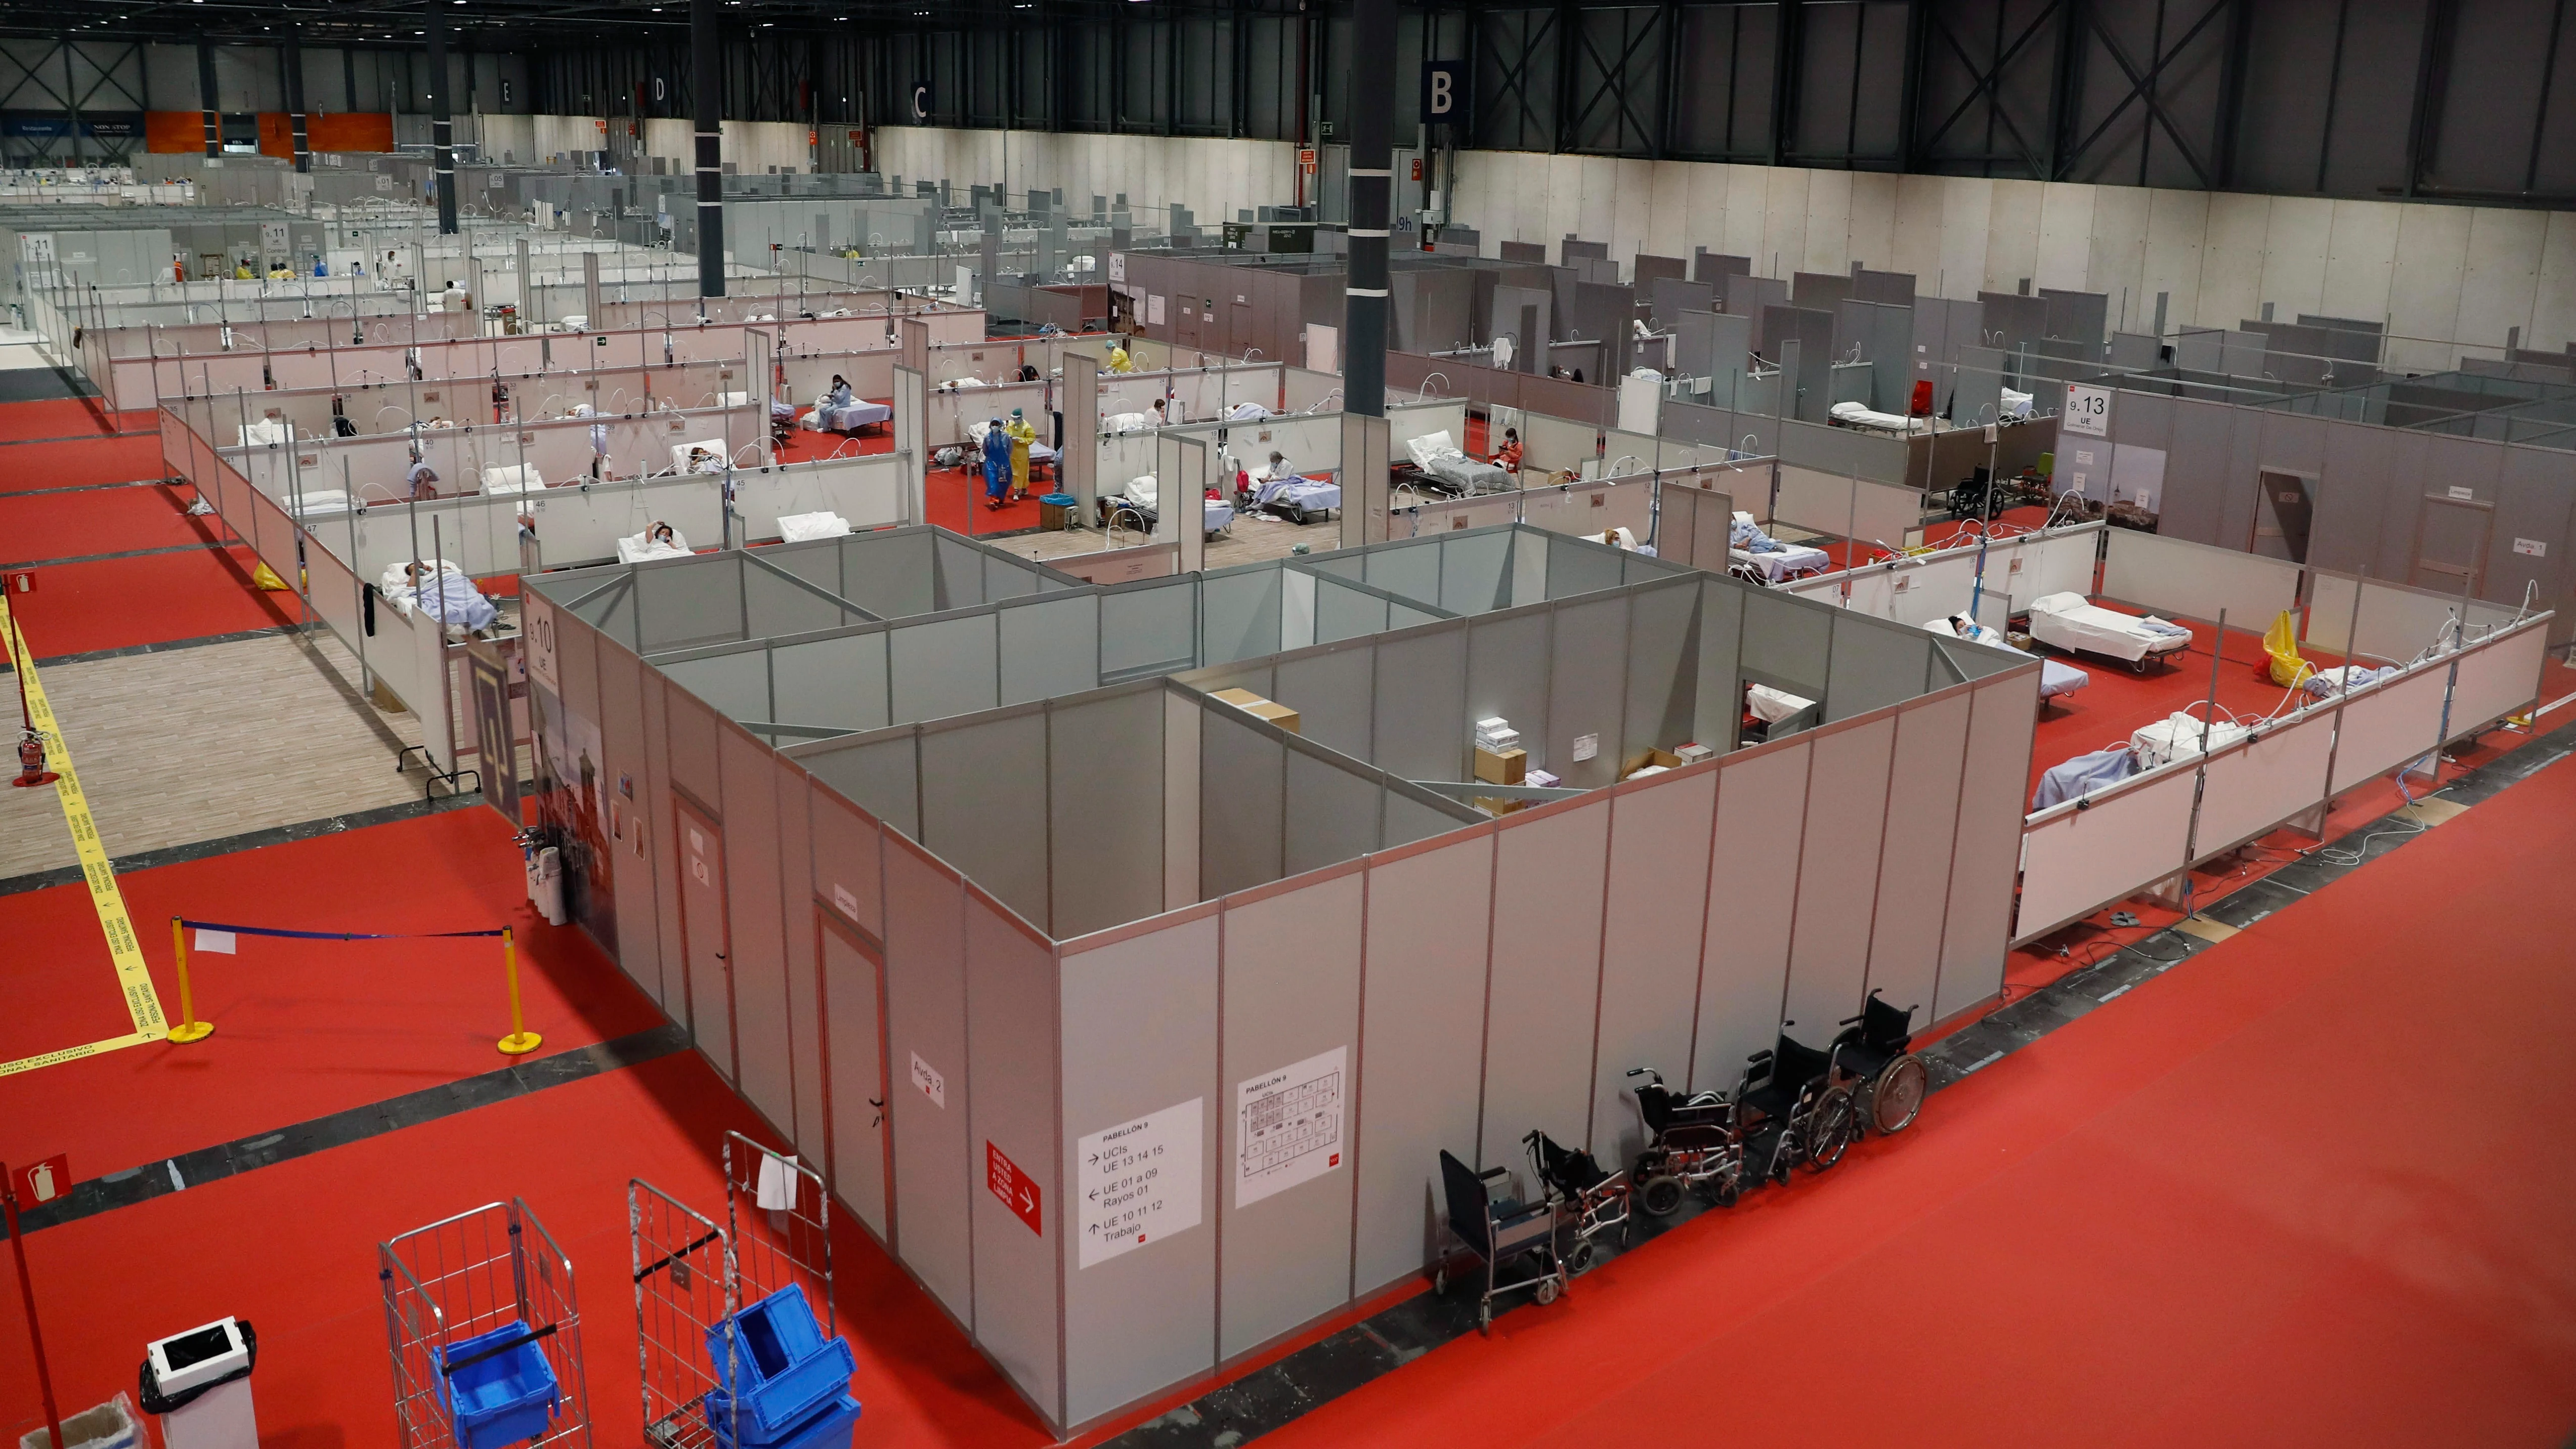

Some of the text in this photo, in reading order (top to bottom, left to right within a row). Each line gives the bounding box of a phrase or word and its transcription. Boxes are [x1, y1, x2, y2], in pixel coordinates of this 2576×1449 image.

[503, 82, 509, 101] E
[656, 78, 664, 100] D
[1431, 71, 1452, 114] B
[915, 87, 926, 117] C
[266, 228, 284, 238] 9.11
[1110, 259, 1123, 269] 9.14
[2070, 396, 2104, 414] 9.13
[2517, 541, 2536, 549] Avda.
[113, 946, 124, 955] ZONA
[122, 934, 135, 952] PERSONAL
[127, 986, 149, 1027] ZONA USO EXCLUSIVO
[139, 983, 161, 1024] PERSONAL SANITARIO
[27, 1045, 93, 1063] EXCLUSIVO
[34, 1049, 95, 1067] SANITARIO
[914, 1060, 941, 1092] Avda. 2
[1246, 1077, 1281, 1094] PABELLÓN
[1103, 1124, 1142, 1142] PABELLÓN
[993, 1149, 1011, 1173] ENTRA
[1103, 1145, 1128, 1160] UCIs
[1103, 1144, 1163, 1173] UE 13 14 15
[993, 1161, 1011, 1183] USTED
[1104, 1182, 1119, 1195] UE
[1122, 1176, 1133, 1188] 01
[1145, 1168, 1157, 1179] 09
[992, 1172, 1013, 1197] A ZONA
[994, 1183, 1012, 1207] LIMPIA
[1103, 1184, 1148, 1208] Rayos 01
[1104, 1200, 1163, 1229] UE 10 11 12
[1104, 1223, 1141, 1242] Trabajo
